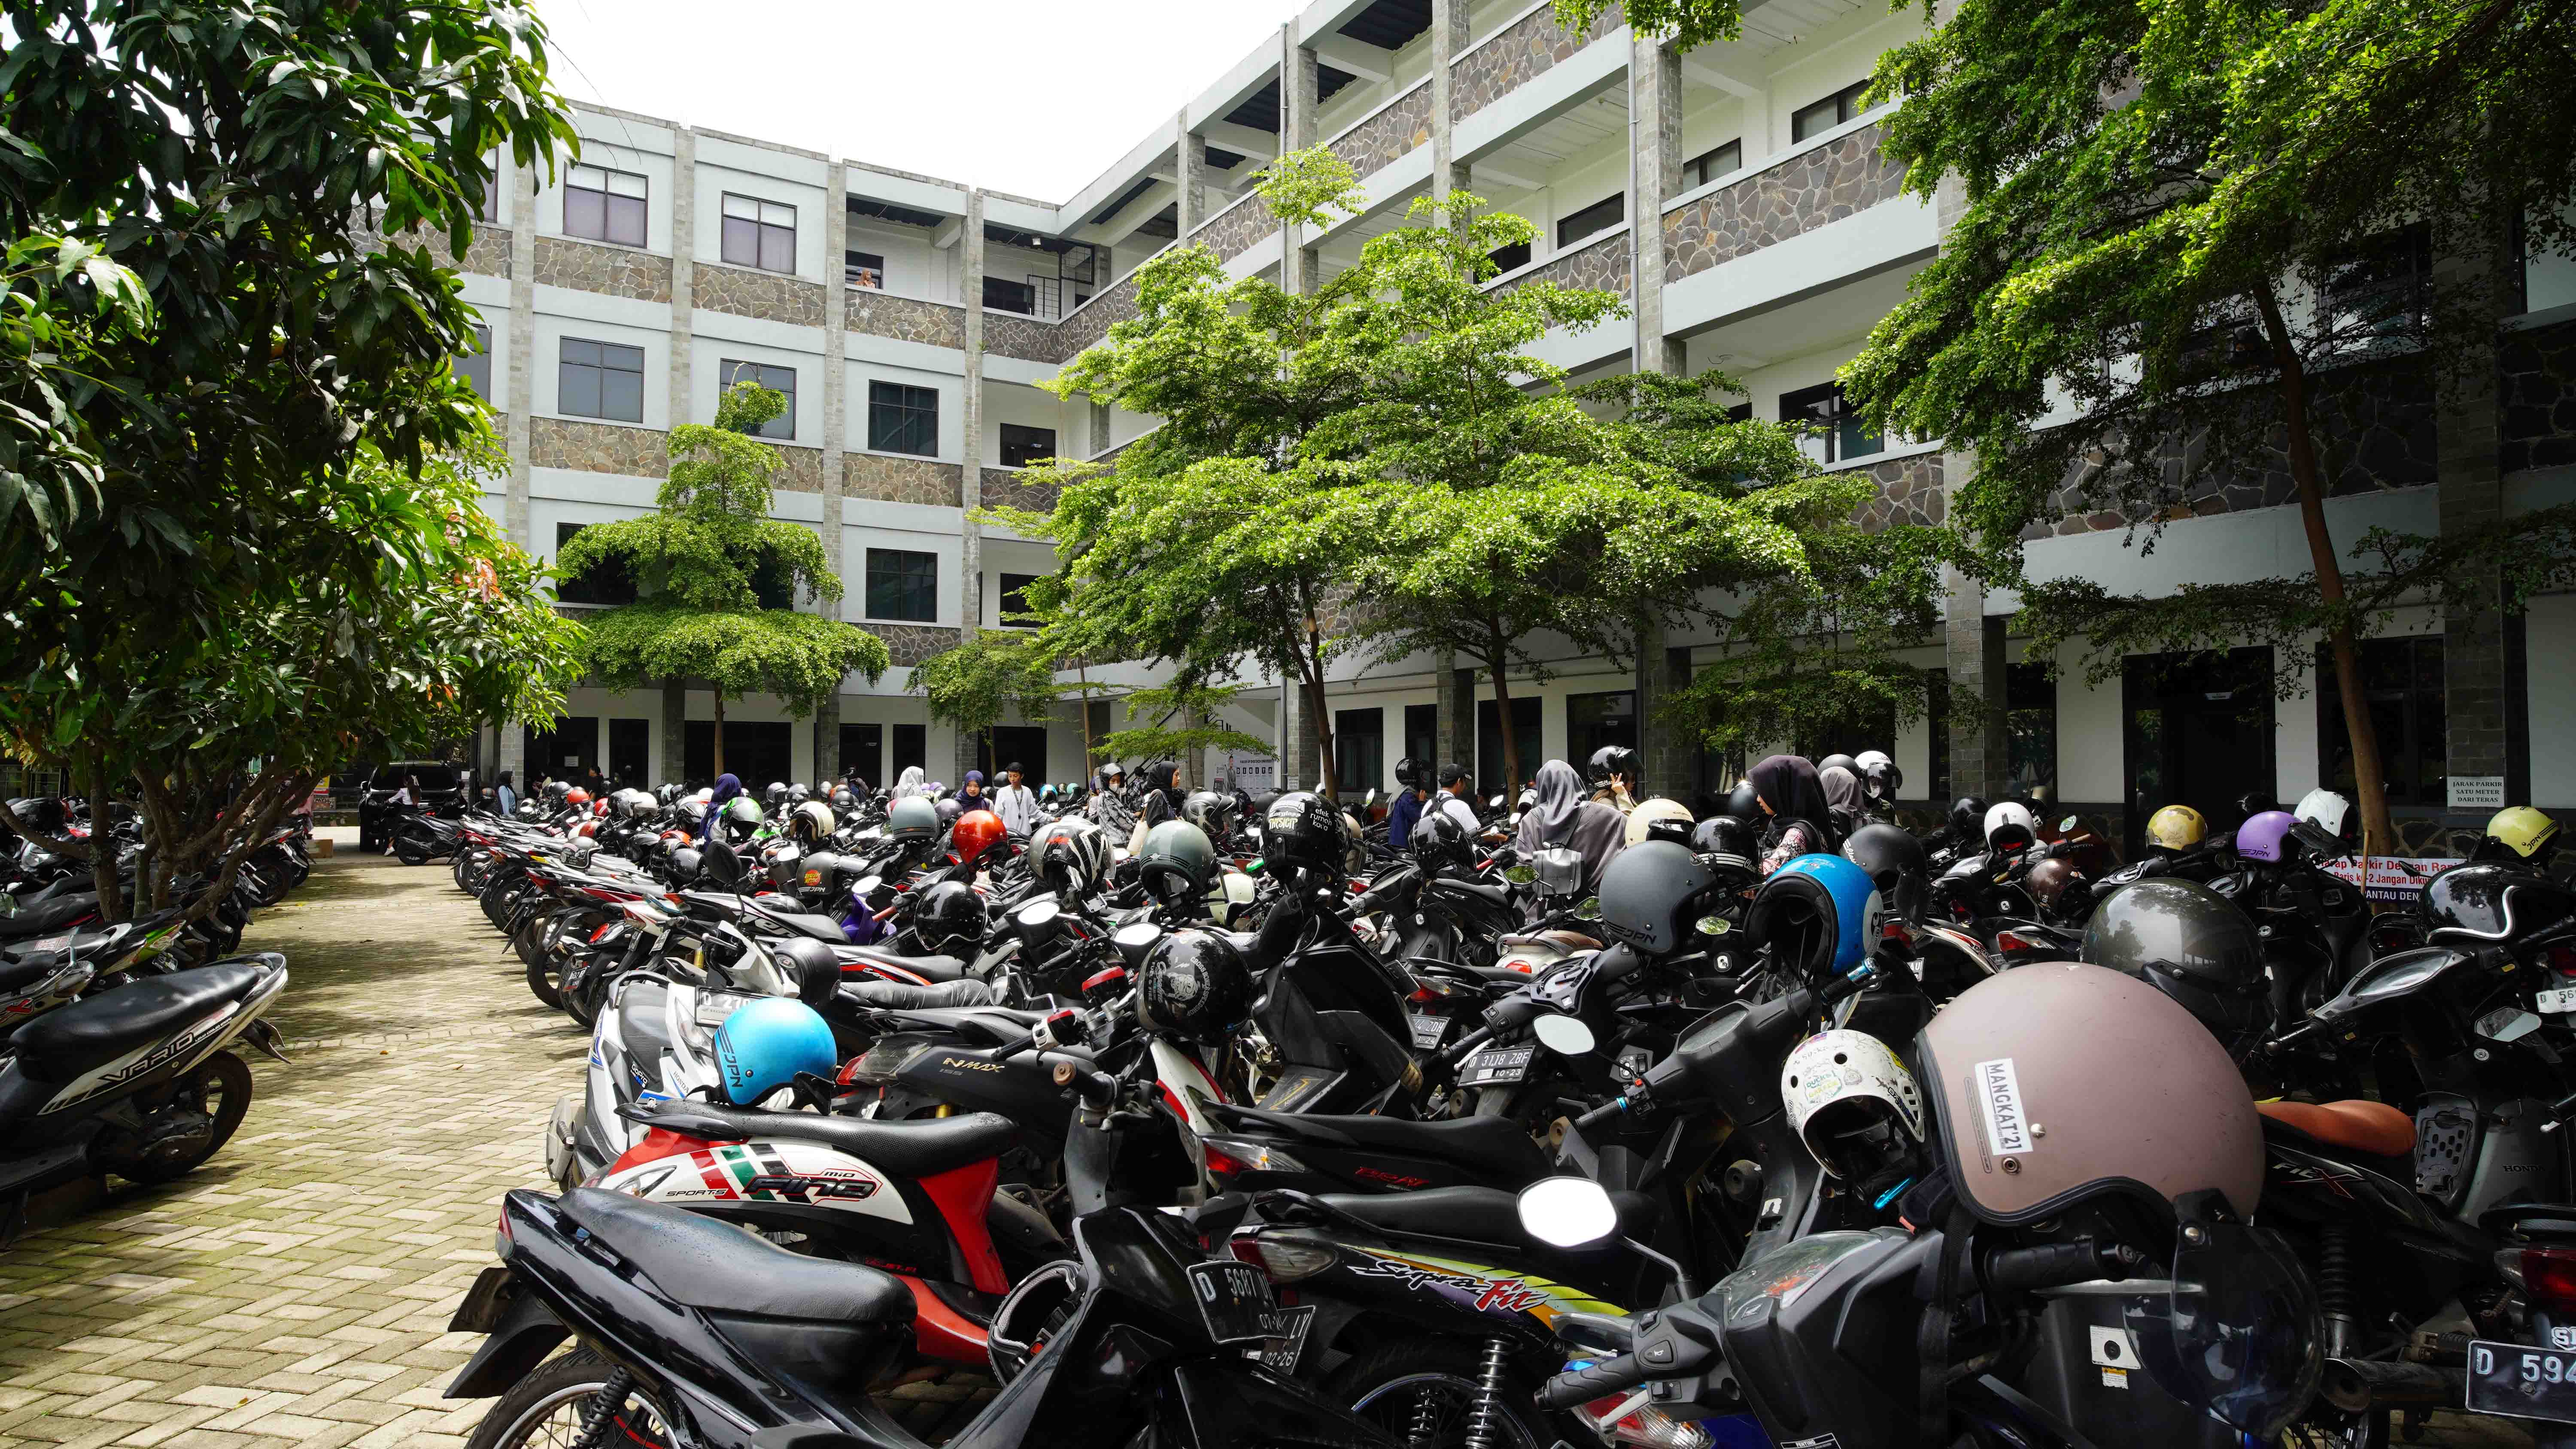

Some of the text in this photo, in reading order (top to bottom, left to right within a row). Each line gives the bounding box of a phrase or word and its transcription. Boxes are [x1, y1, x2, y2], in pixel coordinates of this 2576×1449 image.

[1310, 813, 1332, 826] rumah
[1315, 808, 1329, 817] efek
[2527, 834, 2541, 851] JPN
[2250, 849, 2271, 858] JPN
[2353, 859, 2382, 870] Pakir
[2387, 861, 2427, 872] Dean
[2376, 874, 2406, 885] Jangan
[1624, 928, 1657, 945] JPN
[1190, 956, 1206, 973] CROSS
[702, 991, 711, 1006] D
[2540, 990, 2576, 1003] D 56
[1425, 1021, 1445, 1033] ZDH
[99, 1033, 193, 1081] VARIO
[1482, 1054, 1506, 1067] 3118
[1508, 1052, 1530, 1064] ZBF
[724, 1054, 743, 1087] JPN
[942, 1058, 1005, 1073] NMAX
[673, 1071, 690, 1093] HONDA
[666, 1189, 727, 1197] SPORTS
[1196, 1272, 1216, 1302] D
[1474, 1278, 1549, 1312] Fit
[2476, 1348, 2493, 1375] D
